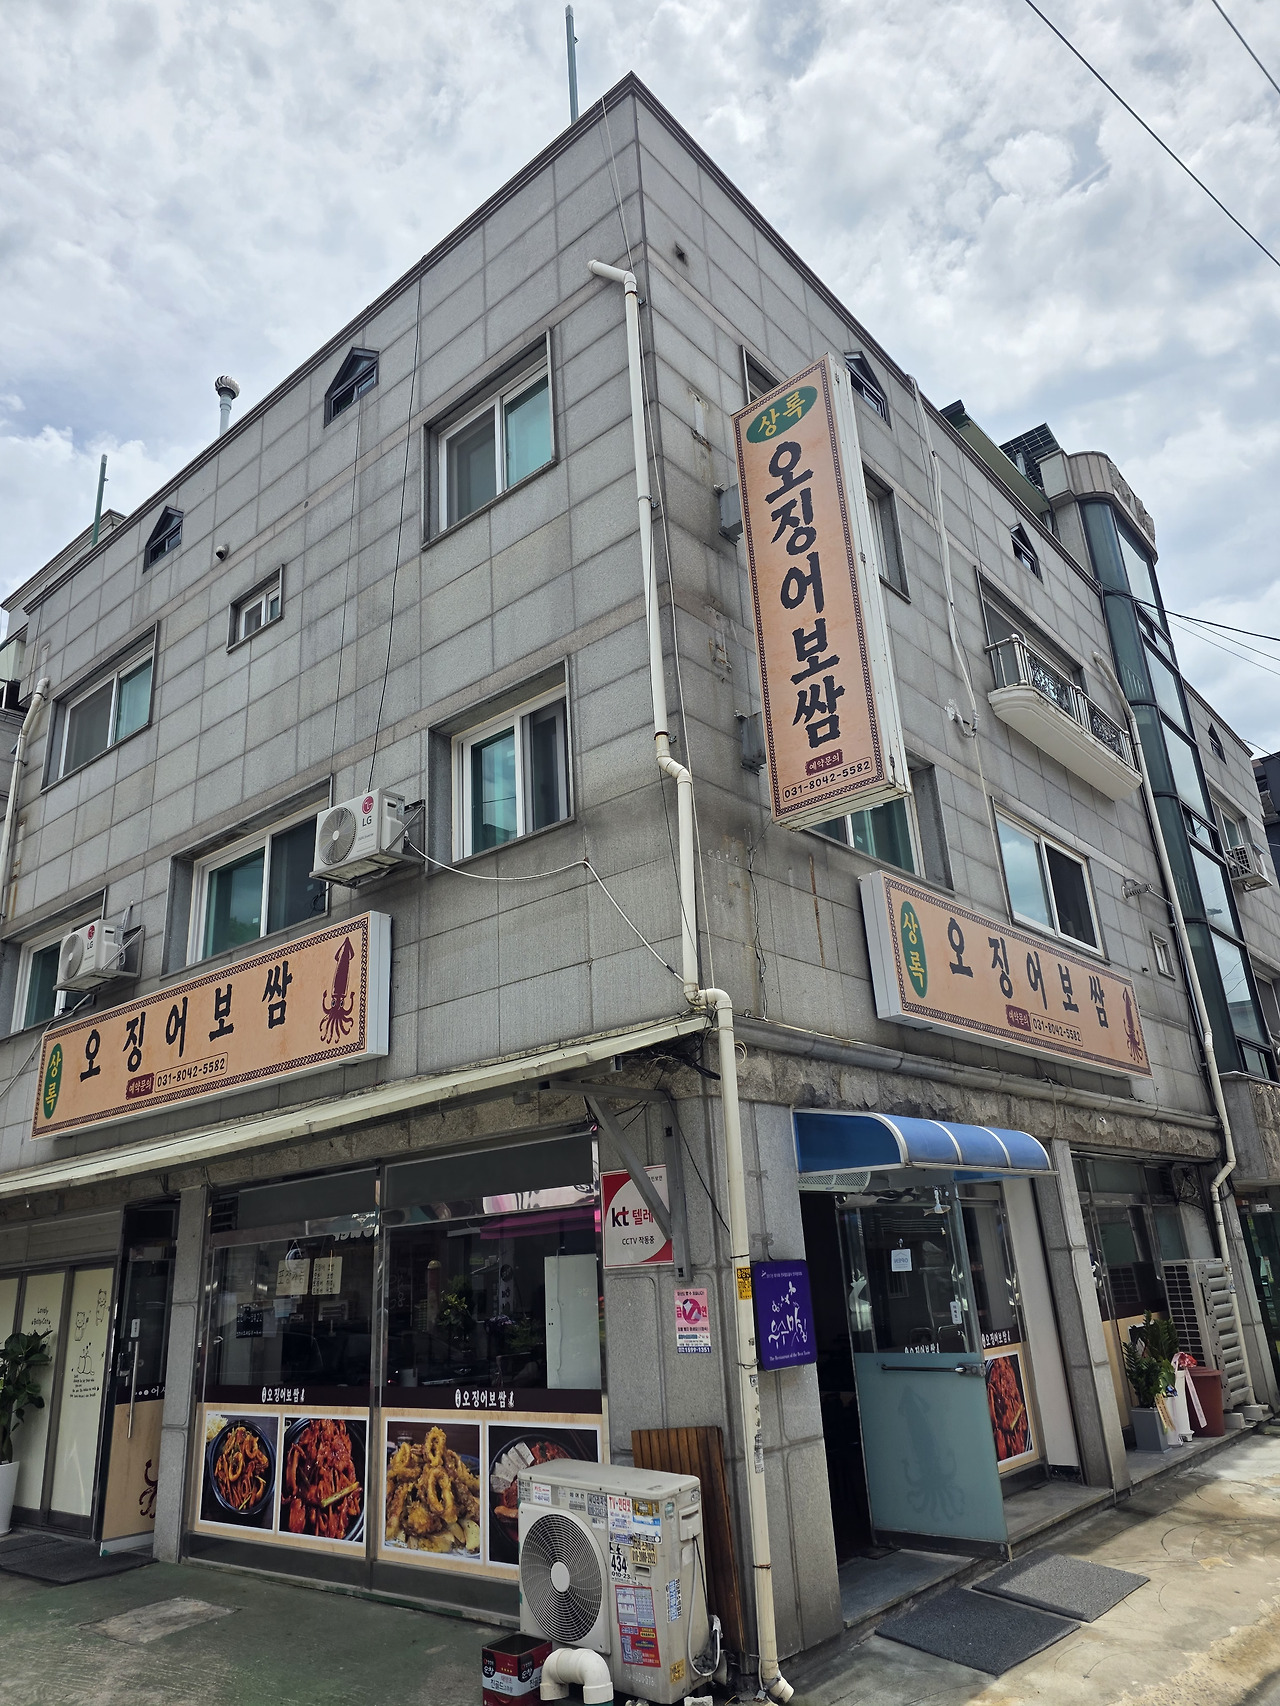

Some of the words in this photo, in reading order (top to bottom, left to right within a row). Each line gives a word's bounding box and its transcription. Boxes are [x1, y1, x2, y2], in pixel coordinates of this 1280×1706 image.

[757, 393, 806, 439] 상록
[764, 440, 846, 749] 오징어보쌈
[808, 752, 840, 771] 예약문의
[784, 760, 872, 800] 031-8042-5582
[362, 815, 373, 827] LG
[86, 940, 94, 950] LG
[902, 911, 925, 988] 상록
[947, 917, 1109, 1028] 오징어보쌈
[79, 960, 293, 1083] 오징어보쌈
[1008, 1009, 1030, 1027] 예약문의
[1032, 1017, 1082, 1042] 031-8042-5582
[45, 1049, 62, 1110] 상록
[156, 1057, 225, 1088] 031-8042-5582
[128, 1077, 153, 1095] 예약문의
[611, 1206, 629, 1228] kt
[632, 1208, 654, 1226] 텔레
[621, 1237, 637, 1246] CCTV
[638, 1235, 655, 1245] 작동중
[267, 1387, 300, 1403] 오징어보쌈
[461, 1389, 507, 1408] 오징어보쌈
